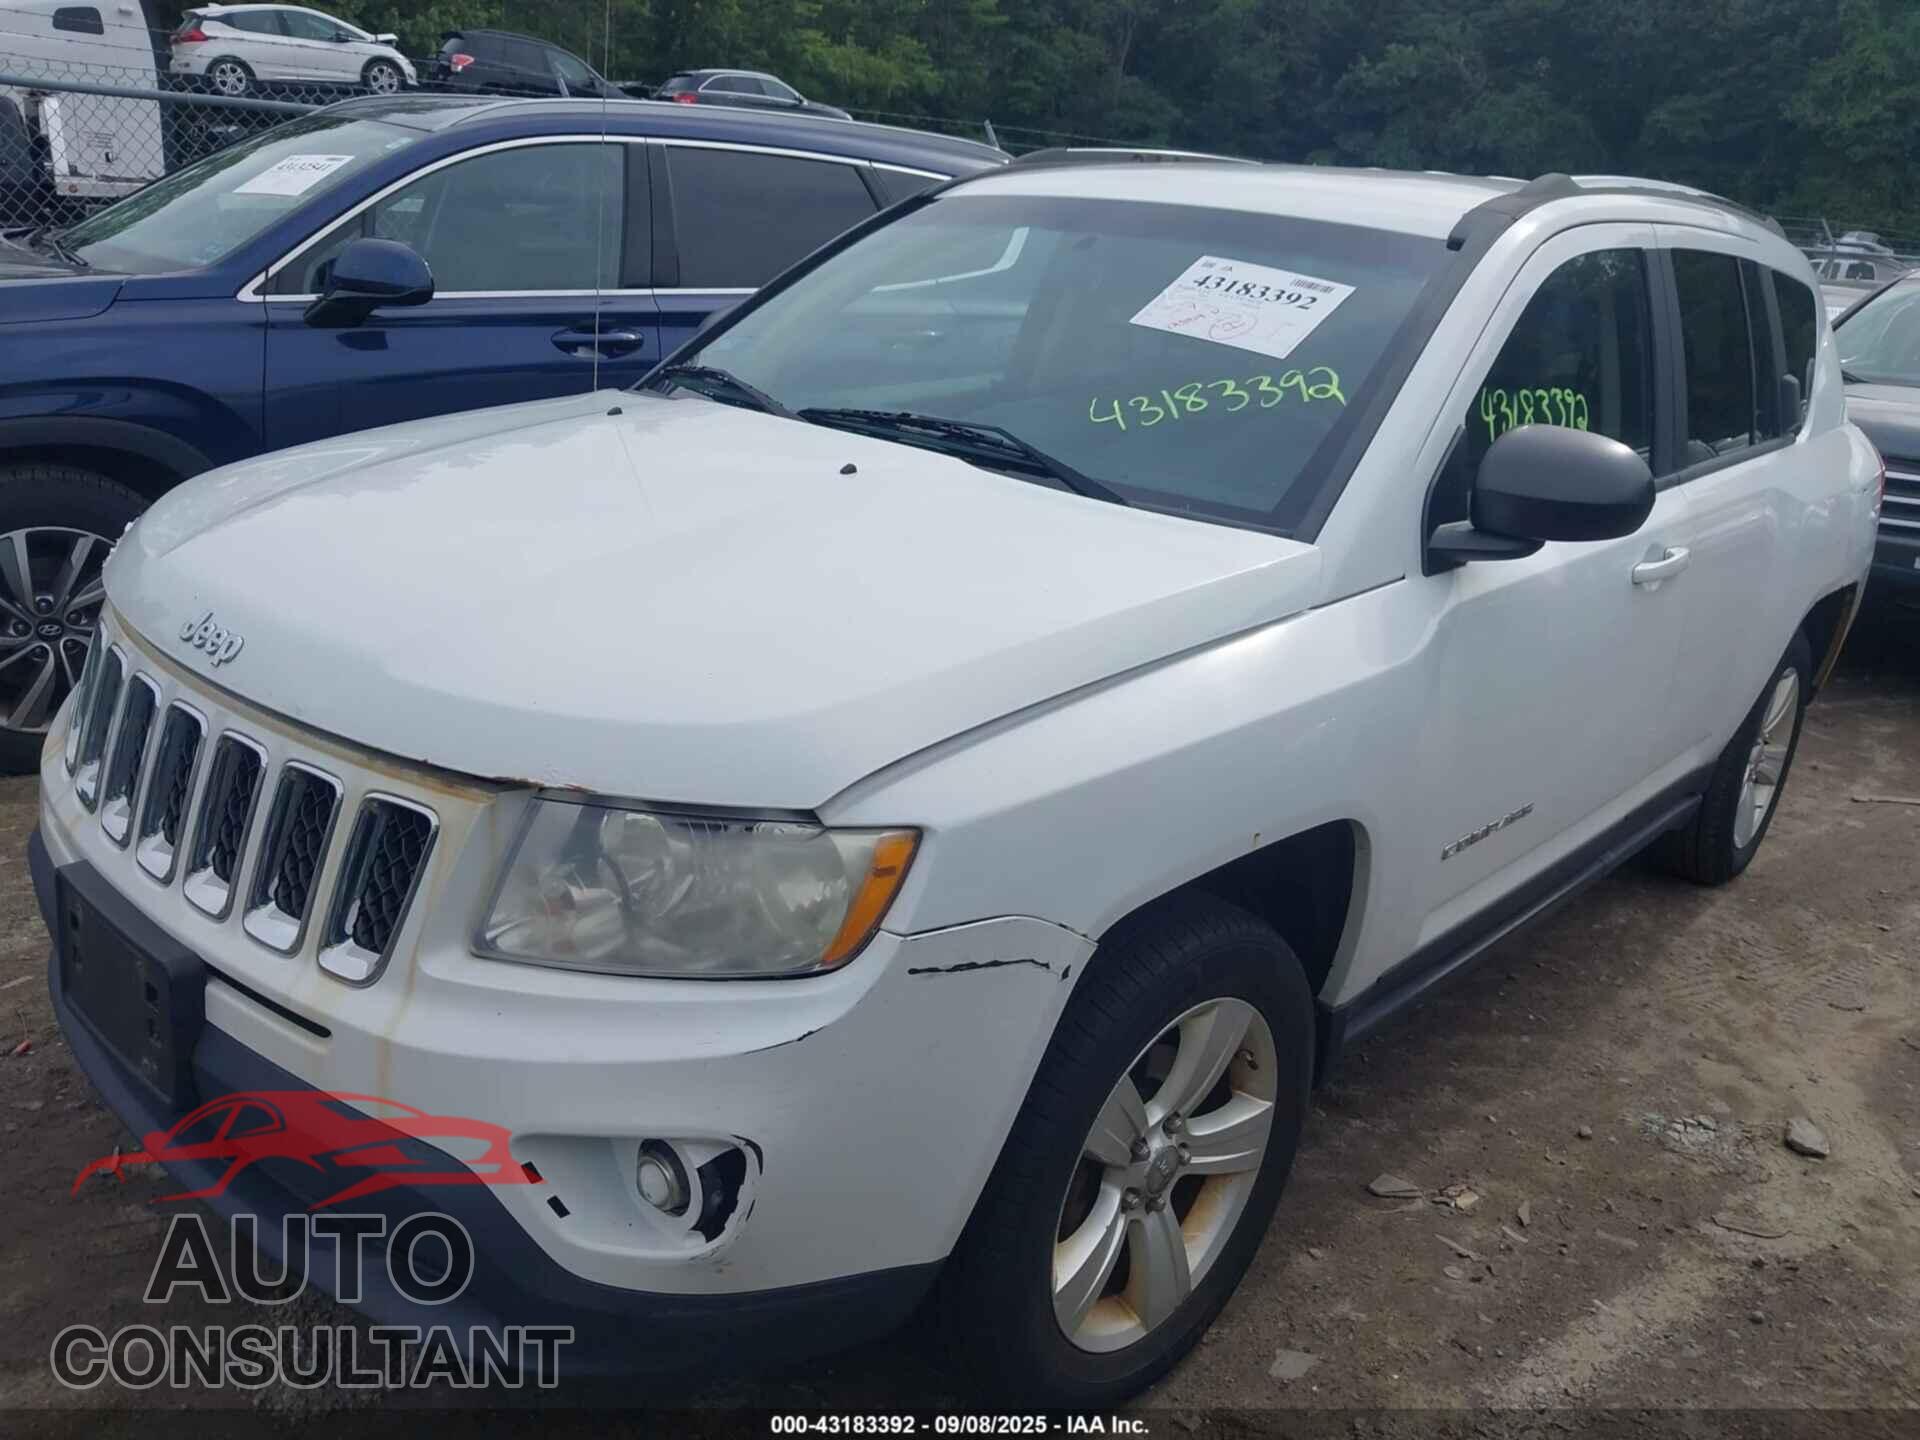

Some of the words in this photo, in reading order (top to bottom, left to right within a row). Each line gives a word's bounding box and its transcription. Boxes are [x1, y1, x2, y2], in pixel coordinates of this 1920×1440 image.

[1193, 273, 1318, 311] 43183392
[1089, 366, 1347, 431] 43183392
[1480, 386, 1589, 442] 43183392
[180, 612, 244, 668] Jeep
